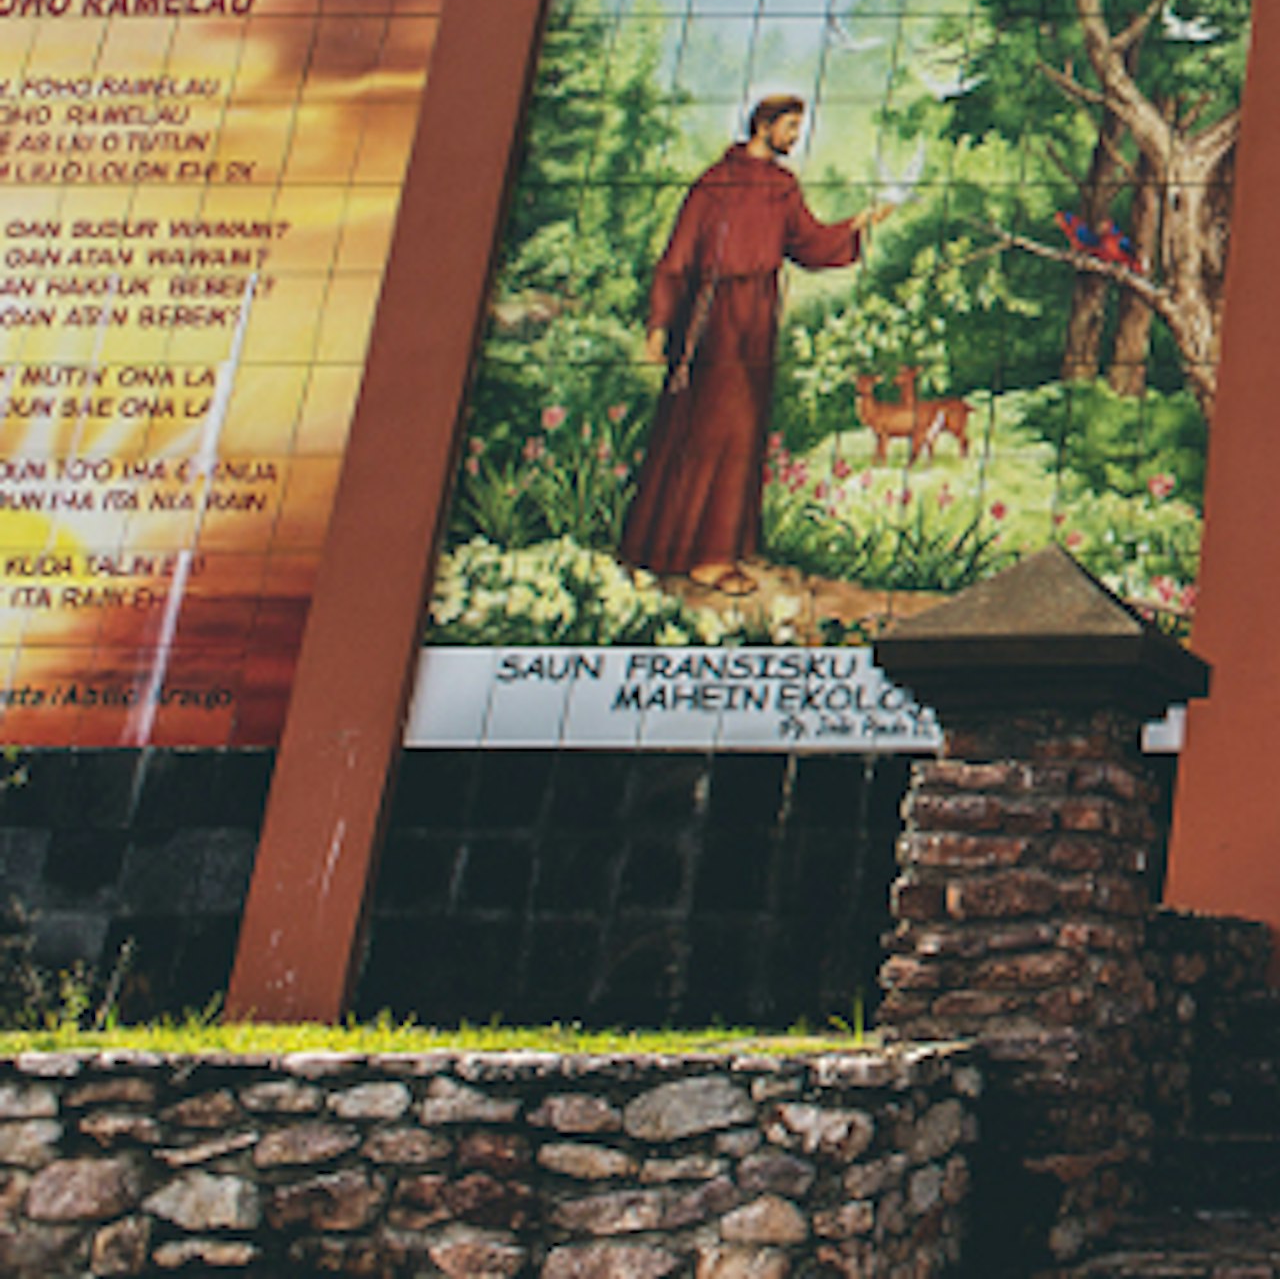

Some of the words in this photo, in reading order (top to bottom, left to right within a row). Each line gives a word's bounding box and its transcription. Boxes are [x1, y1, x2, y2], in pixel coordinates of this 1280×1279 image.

[118, 366, 175, 388] ONA
[118, 396, 175, 419] ONA
[495, 654, 604, 682] SAUN
[626, 653, 857, 681] FRANSISKU
[610, 683, 770, 712] MAHEIN
